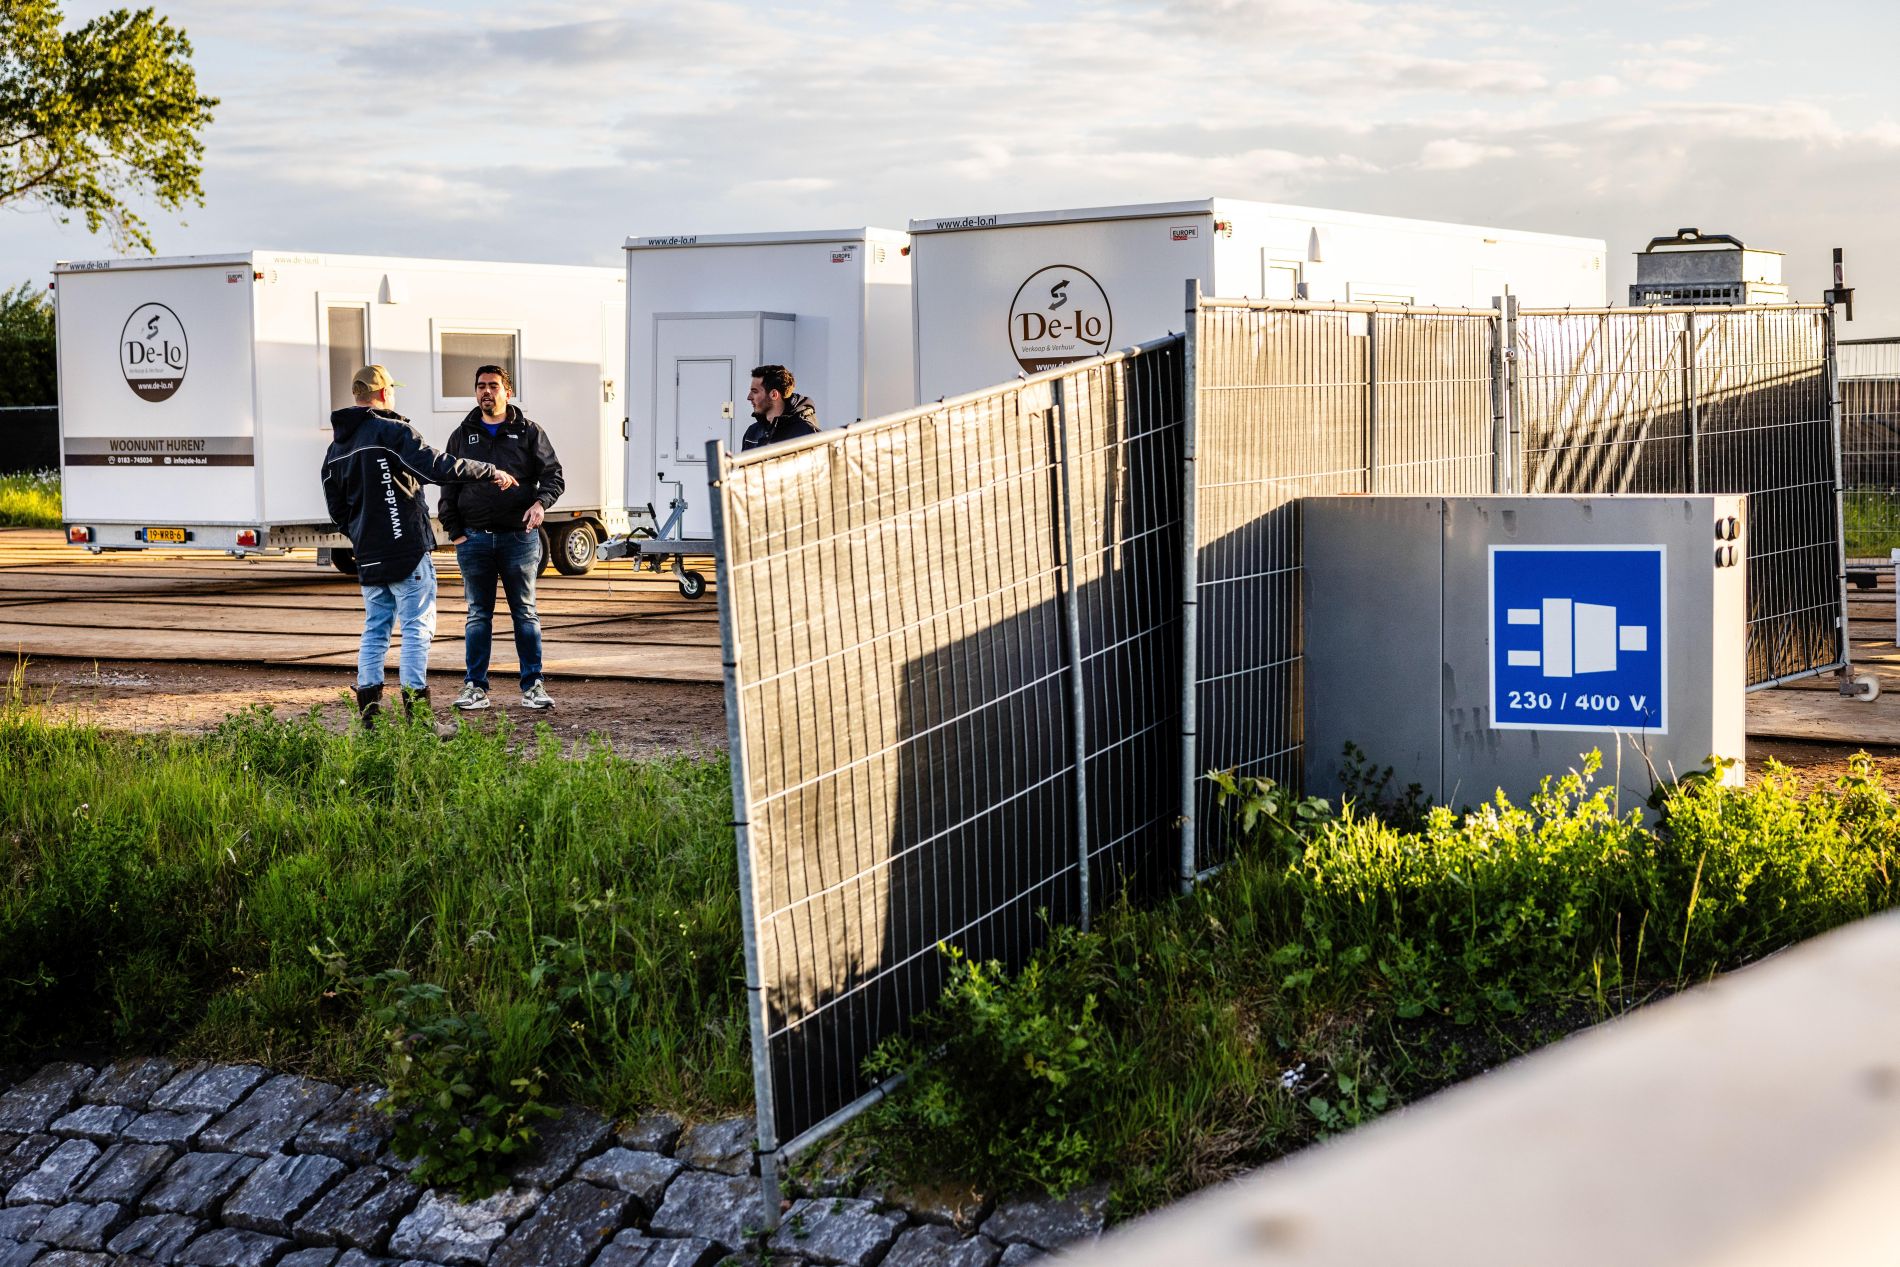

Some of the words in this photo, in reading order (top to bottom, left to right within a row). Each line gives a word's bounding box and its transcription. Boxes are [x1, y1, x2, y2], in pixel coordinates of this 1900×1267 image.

[936, 215, 997, 229] www.de-lo.nl
[648, 235, 697, 246] www.de-lo.nl
[70, 260, 110, 270] www.de-lo.nl
[1021, 345, 1046, 353] Verkoop
[137, 381, 174, 390] www.de-lo.nl
[109, 439, 164, 452] WOONUNIT
[166, 439, 205, 452] HUREN?
[173, 456, 208, 465] info@de-lo.nl
[377, 458, 403, 540] www.de-lo.nl
[150, 530, 182, 540] 19-WRB-6
[1508, 691, 1552, 710] 230
[1560, 692, 1567, 711] /
[1575, 693, 1620, 712] 400
[1629, 694, 1647, 712] V
